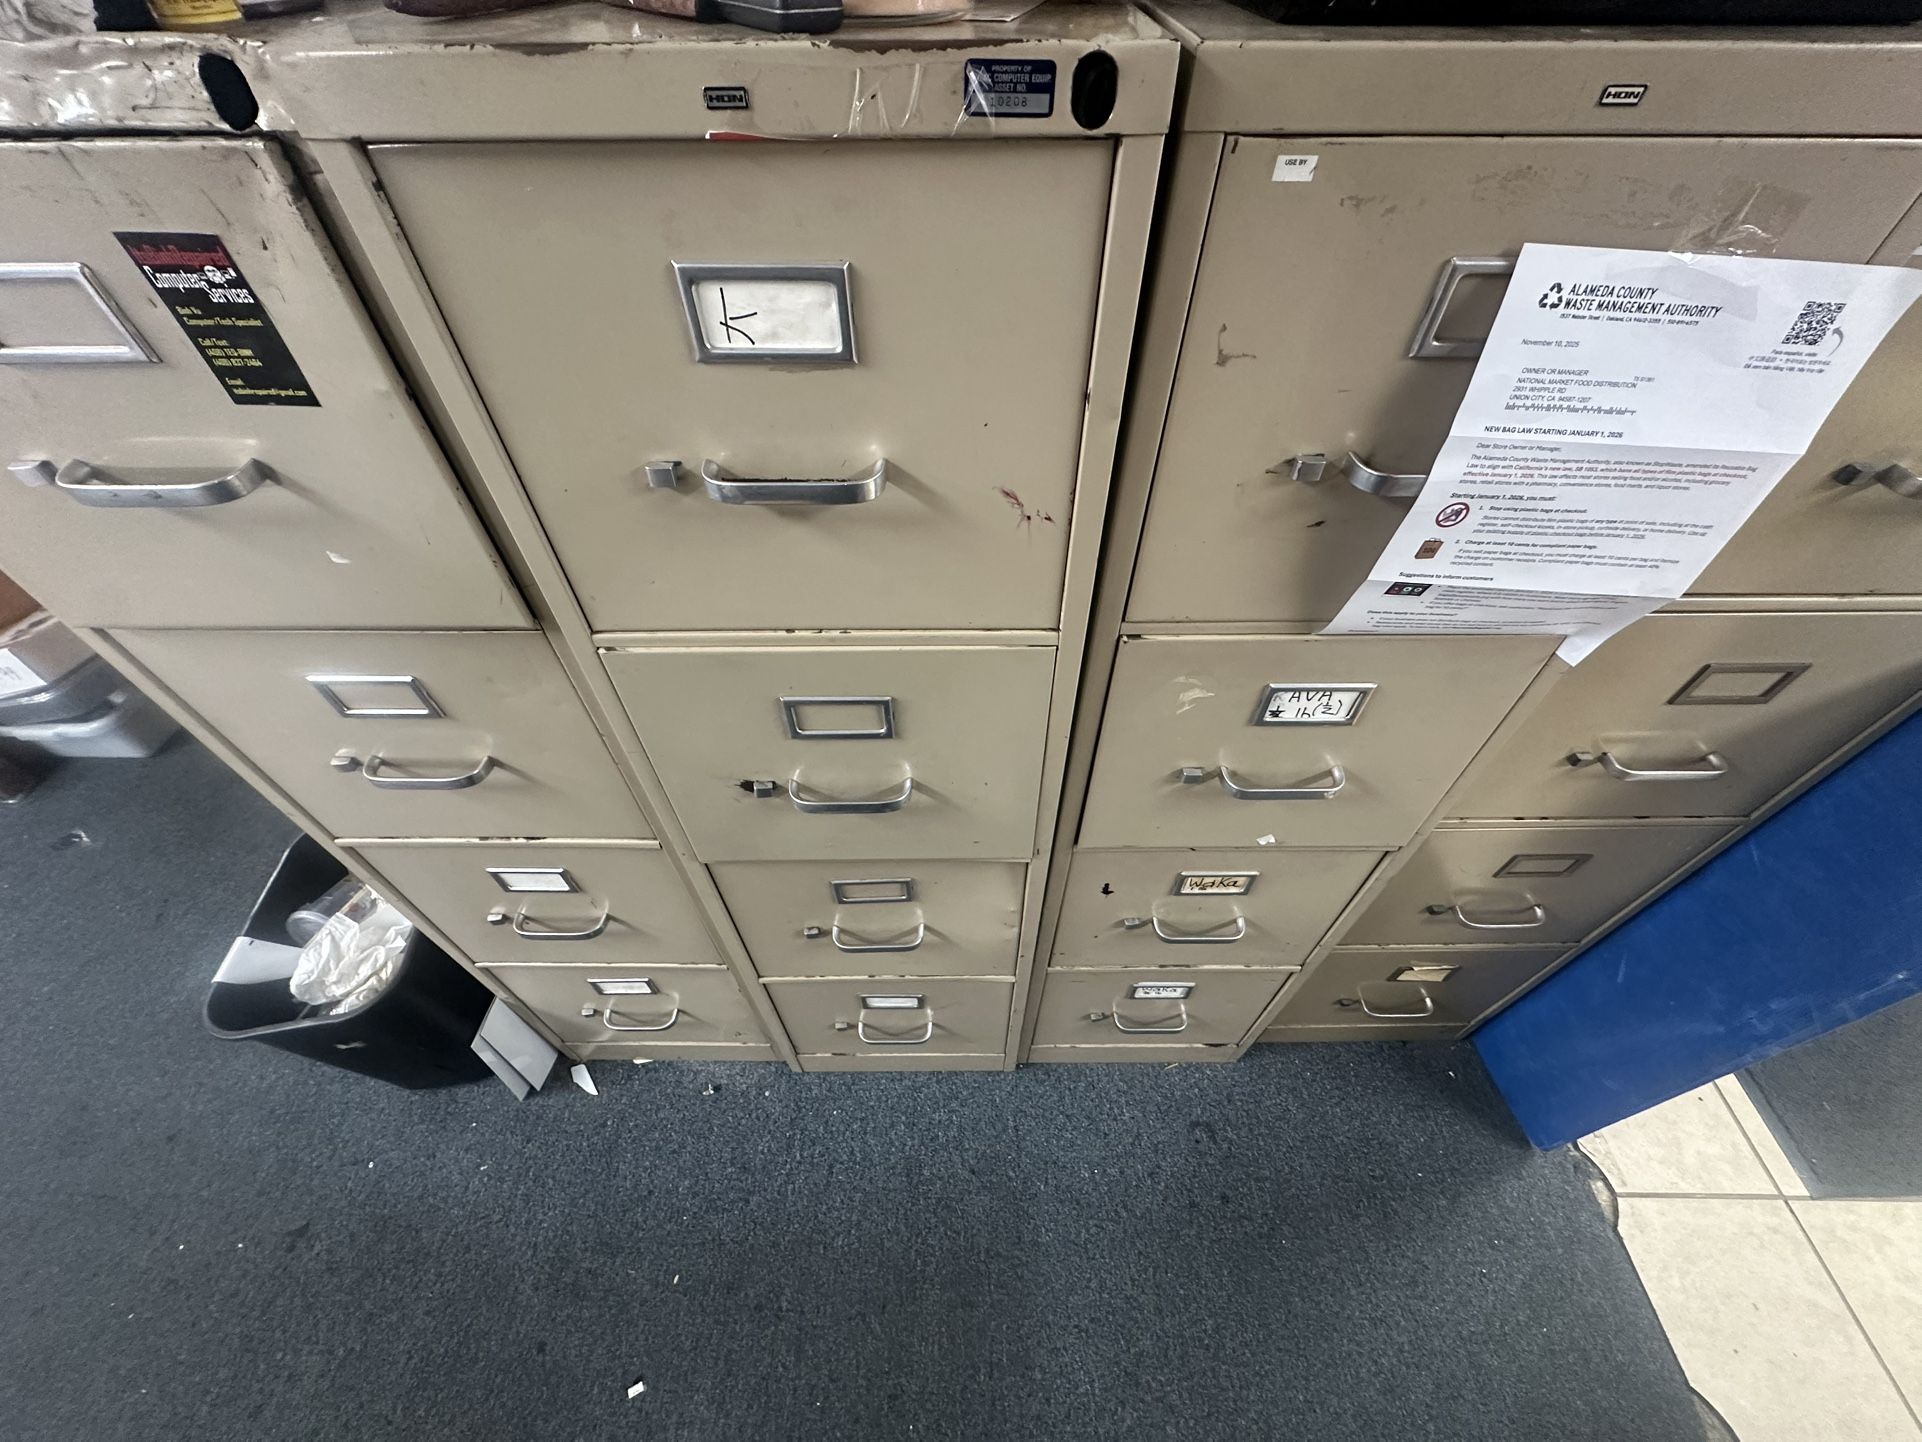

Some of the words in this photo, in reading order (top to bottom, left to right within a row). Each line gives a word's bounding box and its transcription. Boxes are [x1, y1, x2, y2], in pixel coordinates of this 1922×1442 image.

[994, 74, 1029, 82] COMPUTER
[709, 94, 744, 103] HON
[1605, 91, 1641, 99] HON
[990, 97, 1028, 107] 10208
[143, 266, 206, 293] Computer
[199, 281, 254, 303] Services
[1568, 283, 1614, 298] ALAMEDA
[1616, 286, 1658, 300] COUNTY
[1563, 297, 1594, 311] WASTE
[1595, 300, 1663, 315] MANAGEMENT
[1664, 303, 1724, 319] AUTHORITY
[719, 287, 758, 345] K
[1522, 339, 1553, 347] November
